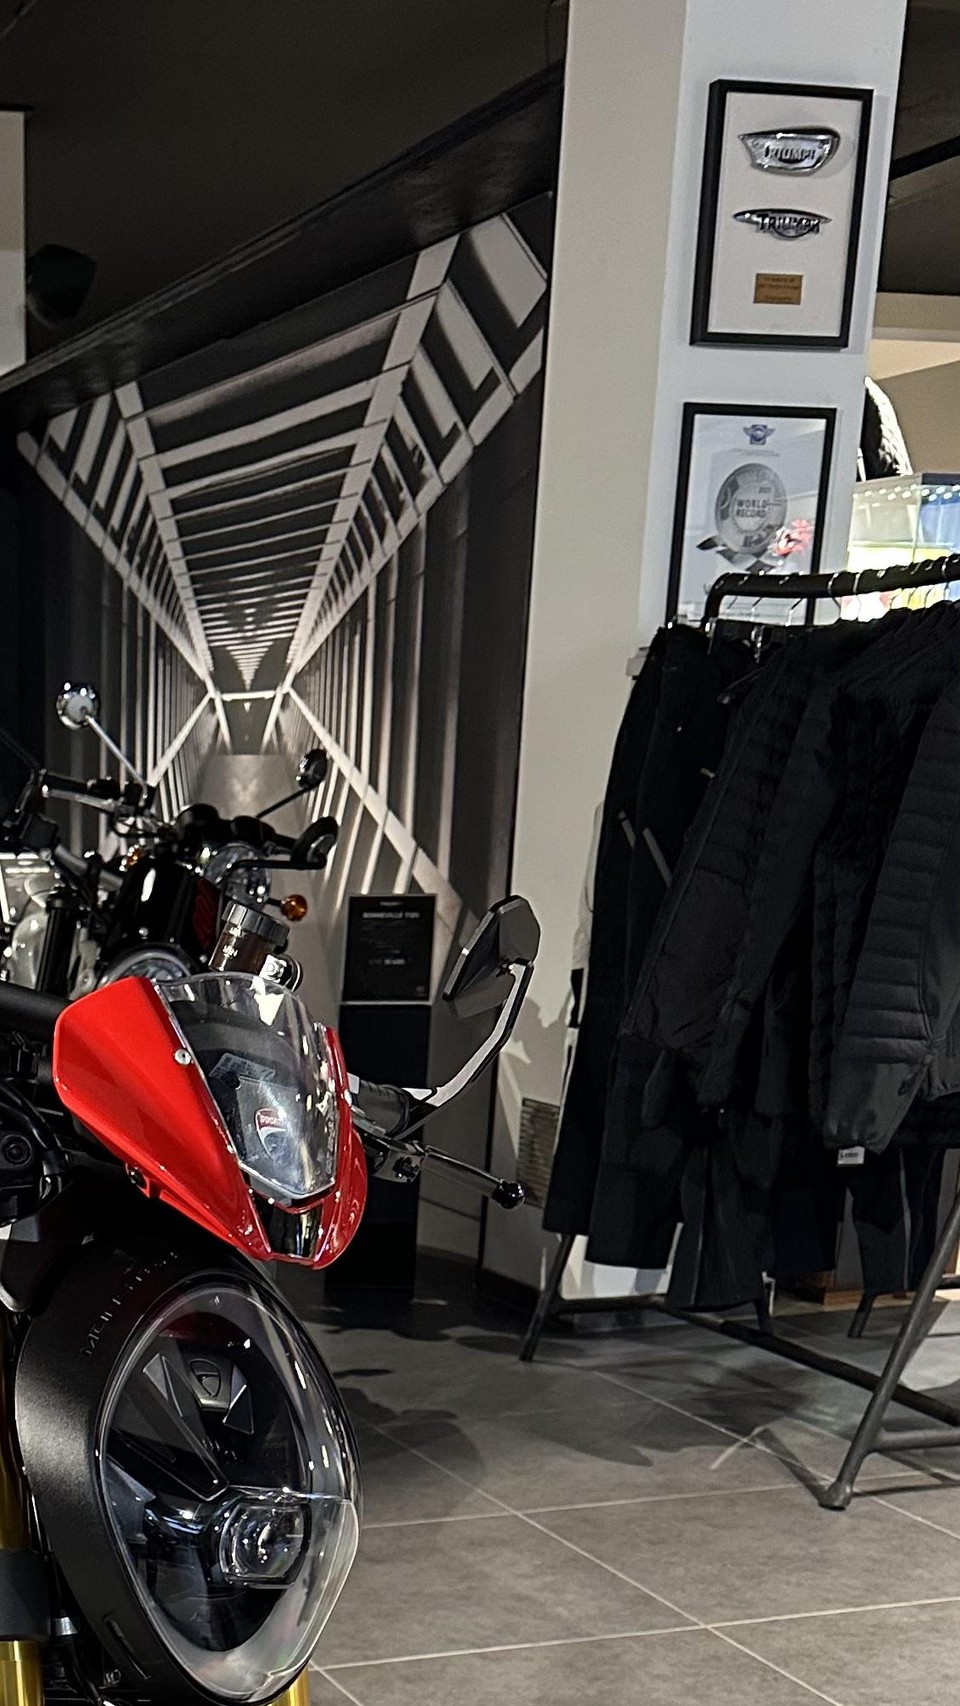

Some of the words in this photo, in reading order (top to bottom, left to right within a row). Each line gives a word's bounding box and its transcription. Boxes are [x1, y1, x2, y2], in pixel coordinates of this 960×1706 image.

[756, 212, 820, 233] TRIUMPH
[736, 500, 768, 509] WORLD
[735, 509, 767, 519] RECORD
